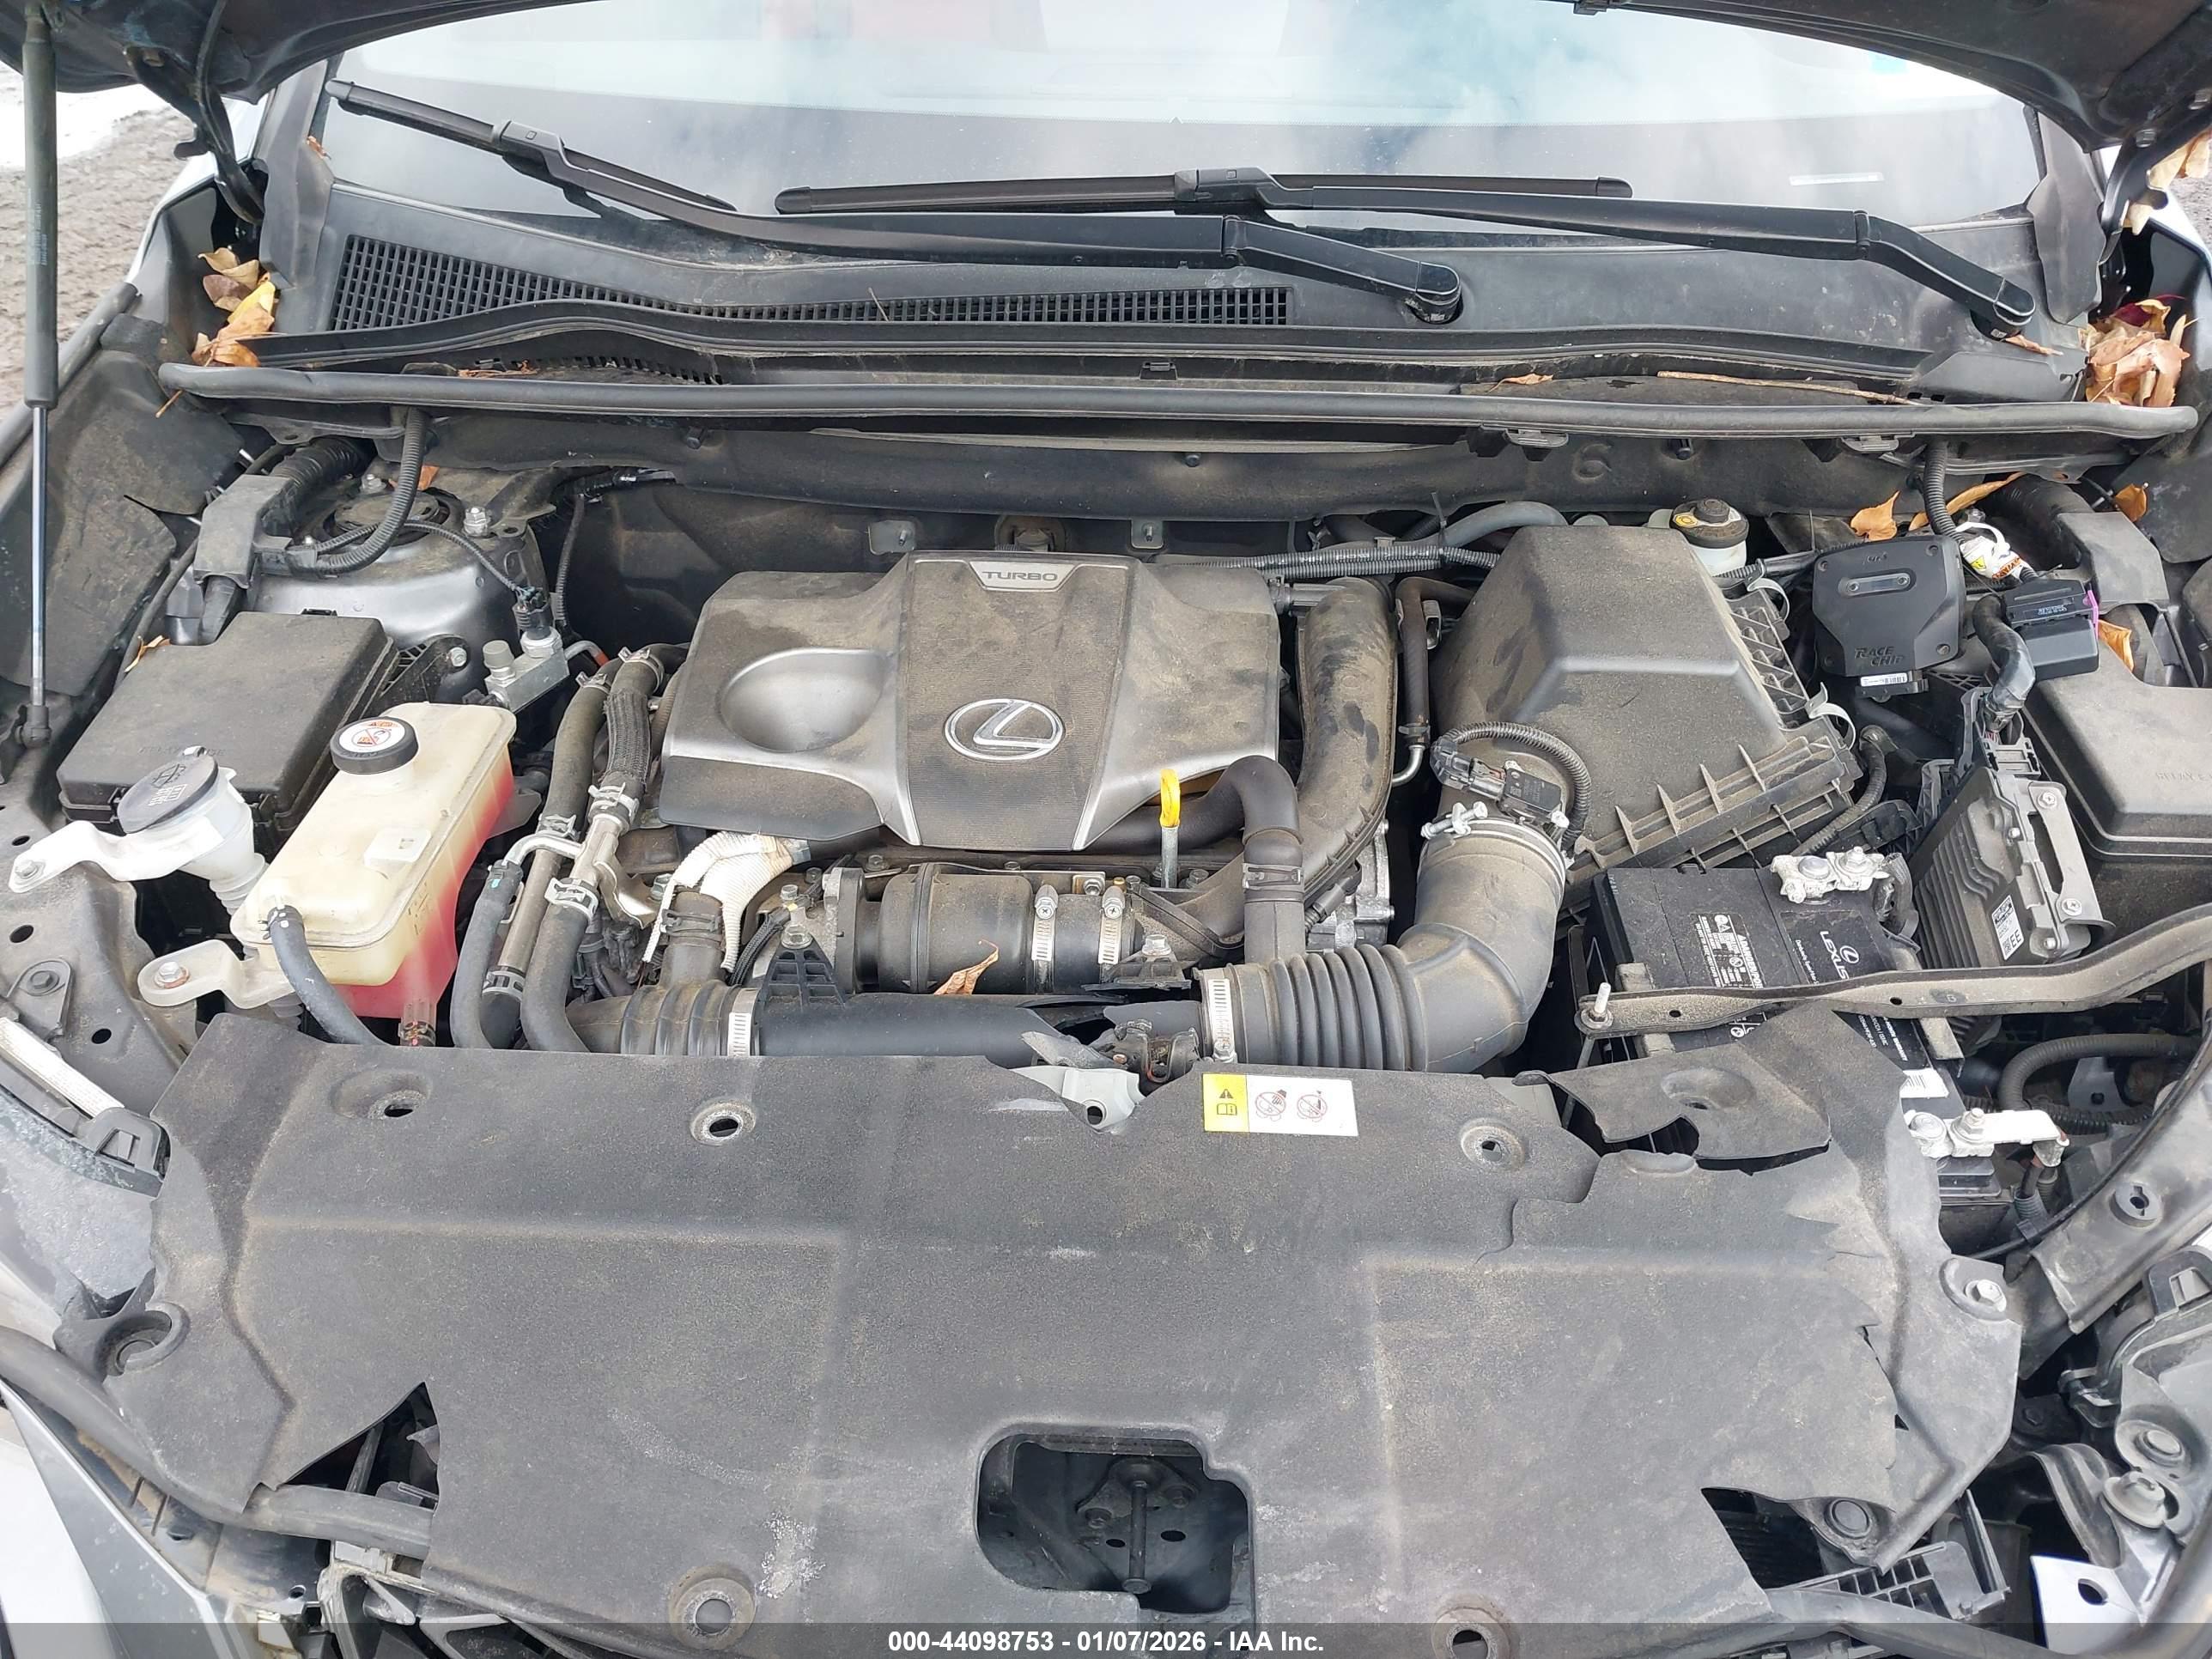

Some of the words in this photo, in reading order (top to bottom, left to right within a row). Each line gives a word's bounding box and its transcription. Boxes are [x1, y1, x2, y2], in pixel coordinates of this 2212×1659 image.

[981, 570, 1059, 581] TURBO
[1854, 646, 1894, 659] RACE
[2009, 929, 2021, 948] EE
[1820, 931, 1850, 980] LEXUS
